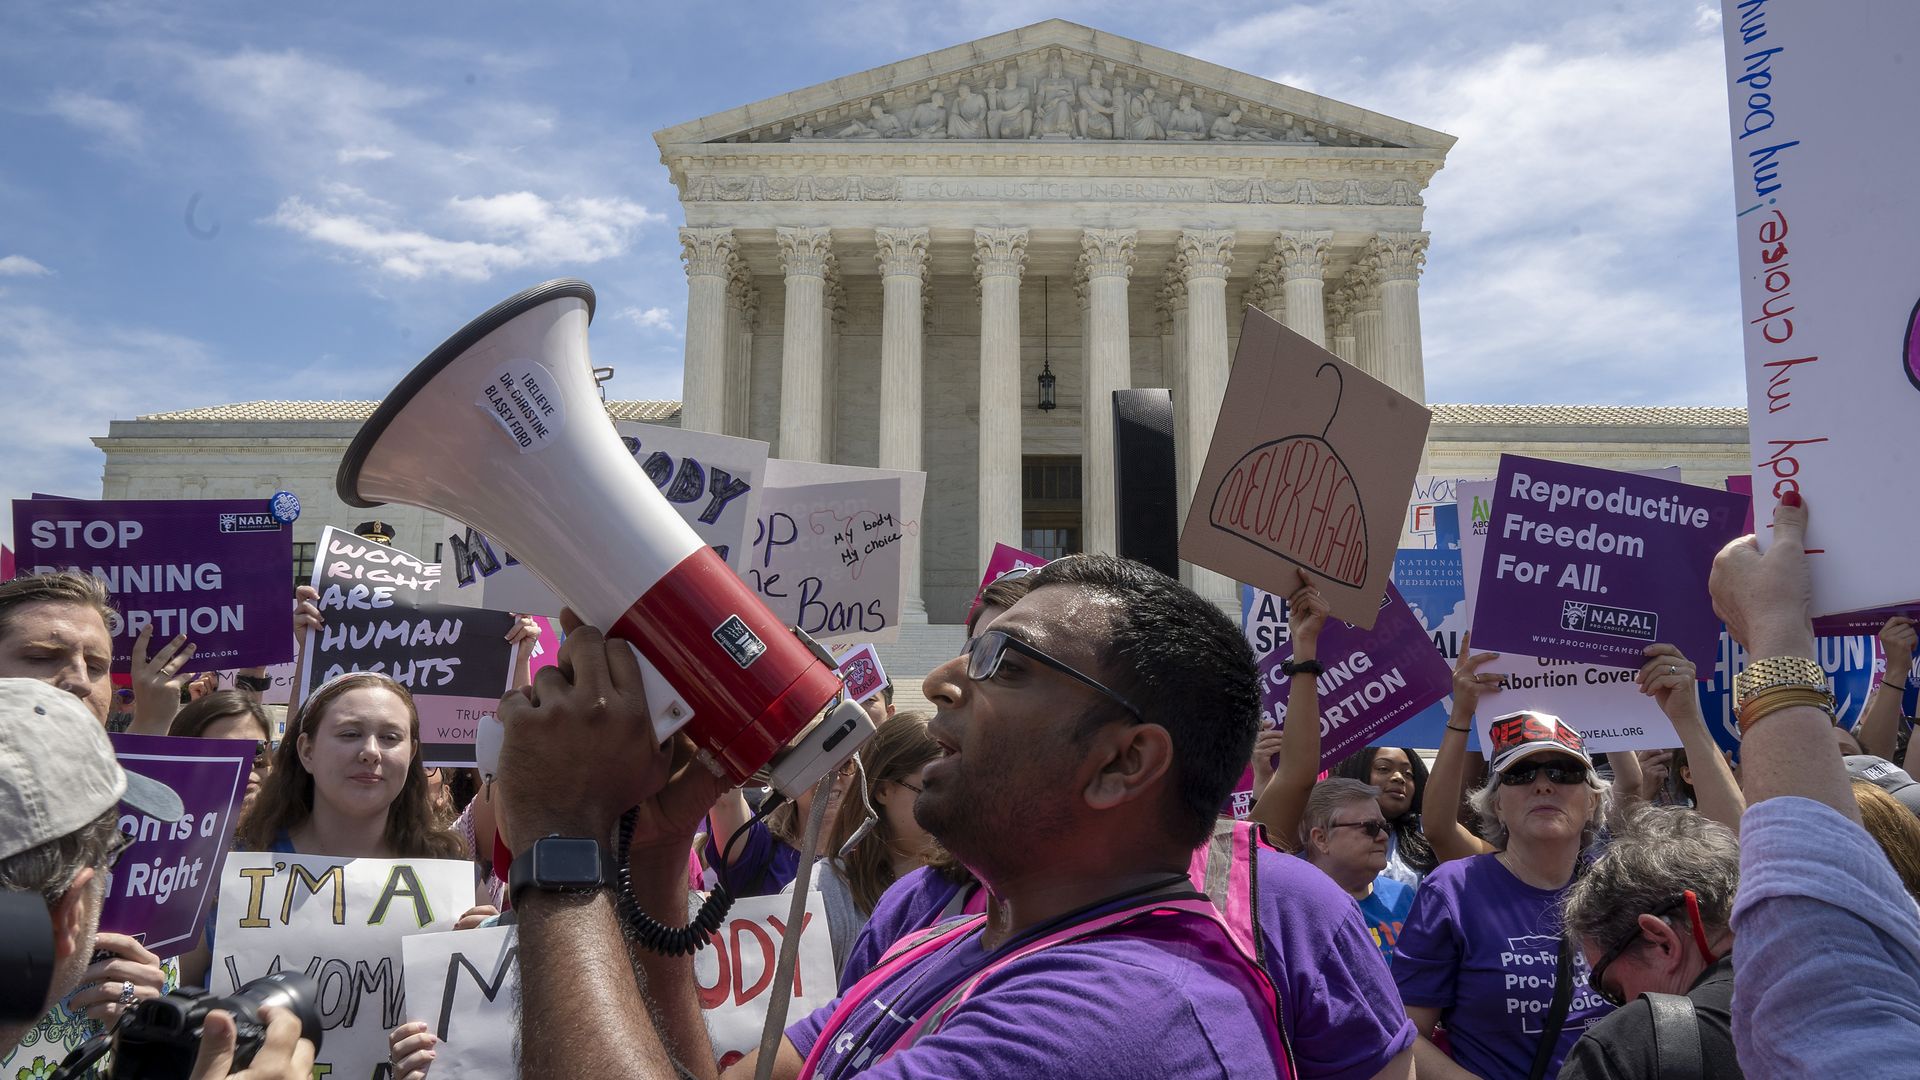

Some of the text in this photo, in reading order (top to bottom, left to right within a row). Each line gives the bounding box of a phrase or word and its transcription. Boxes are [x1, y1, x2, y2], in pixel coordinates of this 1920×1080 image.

[1736, 47, 1784, 140] body
[1748, 139, 1800, 198] my
[991, 182, 1070, 200] JUSTICE
[1082, 182, 1146, 200] UNDER
[1154, 182, 1195, 200] LAW
[521, 372, 555, 417] I BELIEVE
[1763, 356, 1818, 414] my
[485, 384, 532, 448] BLASEY FORD
[500, 372, 549, 439] DR. CHRISTINE
[621, 436, 751, 526] ODY
[1510, 472, 1710, 529] Reproductive
[31, 520, 144, 549] STOP
[238, 516, 278, 526] NARAL
[863, 512, 893, 531] body
[1472, 521, 1489, 529] ABO
[1503, 513, 1645, 558] Freedom
[329, 539, 442, 577] WOME
[864, 533, 904, 555] choice
[328, 560, 441, 591] RIGHT
[1399, 559, 1463, 567] NATIONAL
[1399, 569, 1463, 577] ABORTION
[1496, 553, 1608, 595] For All.
[319, 583, 397, 611] ARE
[1399, 579, 1463, 587] FEDERATION
[798, 576, 886, 634] Bans
[1591, 609, 1652, 630] NARAL
[320, 618, 463, 651] HUMAN
[1532, 635, 1644, 656] WWW.PROCHOICEAMERI
[1499, 668, 1641, 691] Abortion Cover
[1320, 667, 1407, 738] ORTION
[437, 727, 478, 739] WOM
[200, 812, 218, 838] a
[126, 856, 203, 905] Right
[240, 861, 436, 928] I'M A
[694, 912, 813, 1010] ODY
